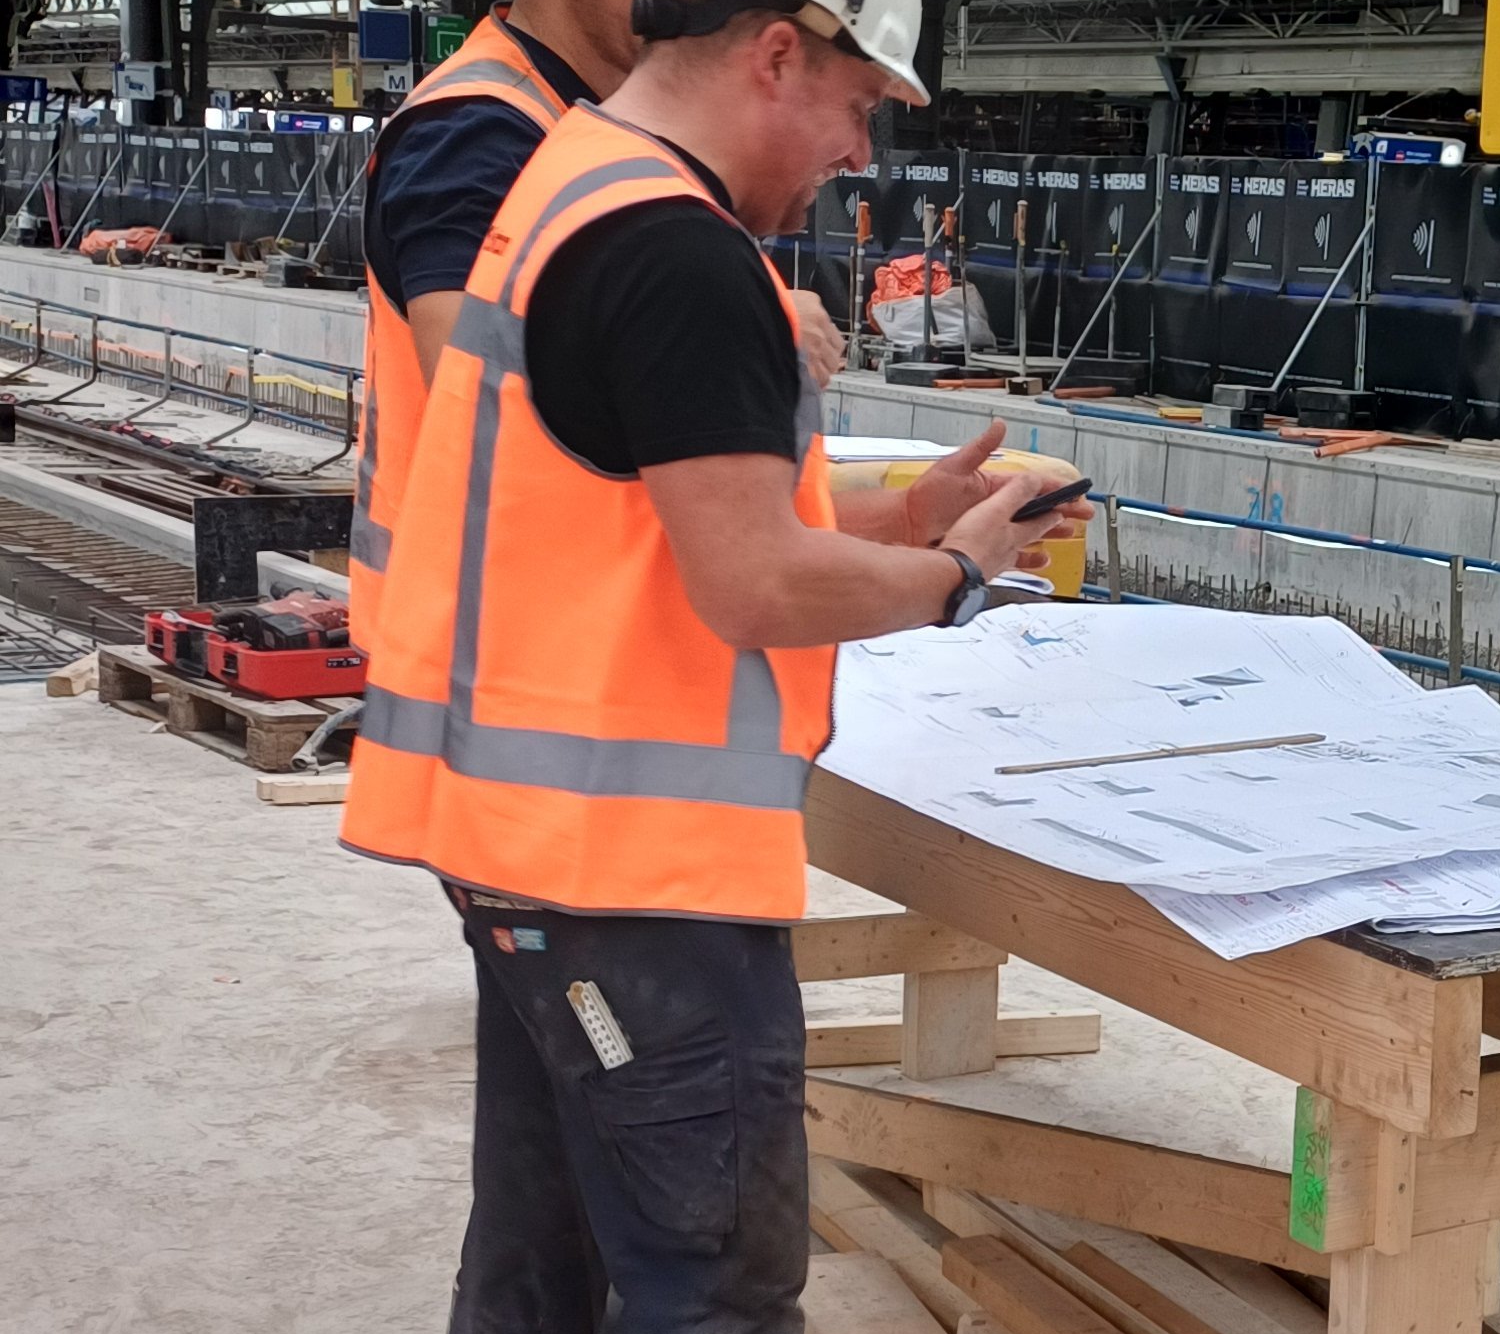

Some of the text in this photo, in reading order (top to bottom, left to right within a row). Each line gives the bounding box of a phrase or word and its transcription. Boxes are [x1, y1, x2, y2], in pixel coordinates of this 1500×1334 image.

[388, 74, 406, 90] M
[214, 96, 227, 108] N
[905, 165, 949, 182] HERAS
[982, 169, 1020, 188] HERAS
[1038, 171, 1079, 190] HERAS
[1103, 173, 1147, 190] HERAS
[1243, 176, 1286, 197] HERAS
[1310, 178, 1356, 198] HERAS
